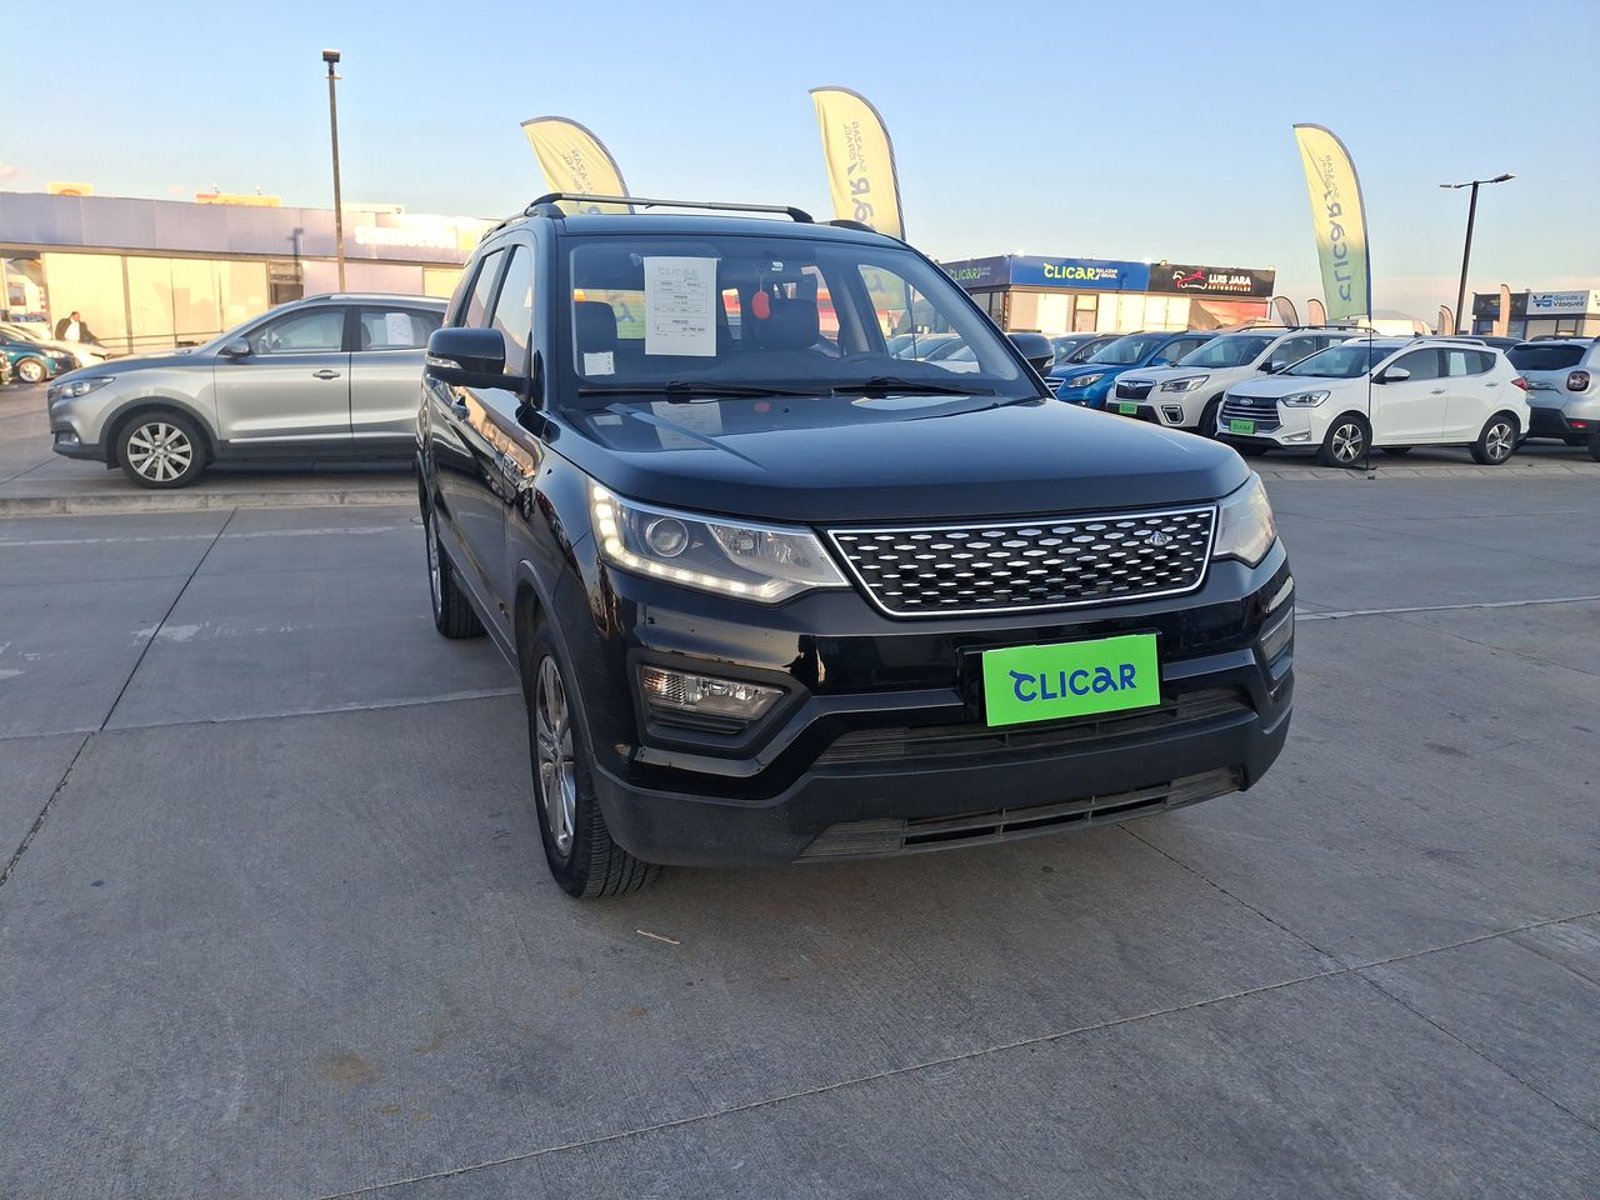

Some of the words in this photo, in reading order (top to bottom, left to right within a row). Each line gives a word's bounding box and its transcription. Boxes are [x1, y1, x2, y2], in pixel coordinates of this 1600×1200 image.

[1208, 273, 1228, 284] LUIS
[1228, 275, 1252, 286] JARA
[1009, 663, 1137, 702] CLICaR
